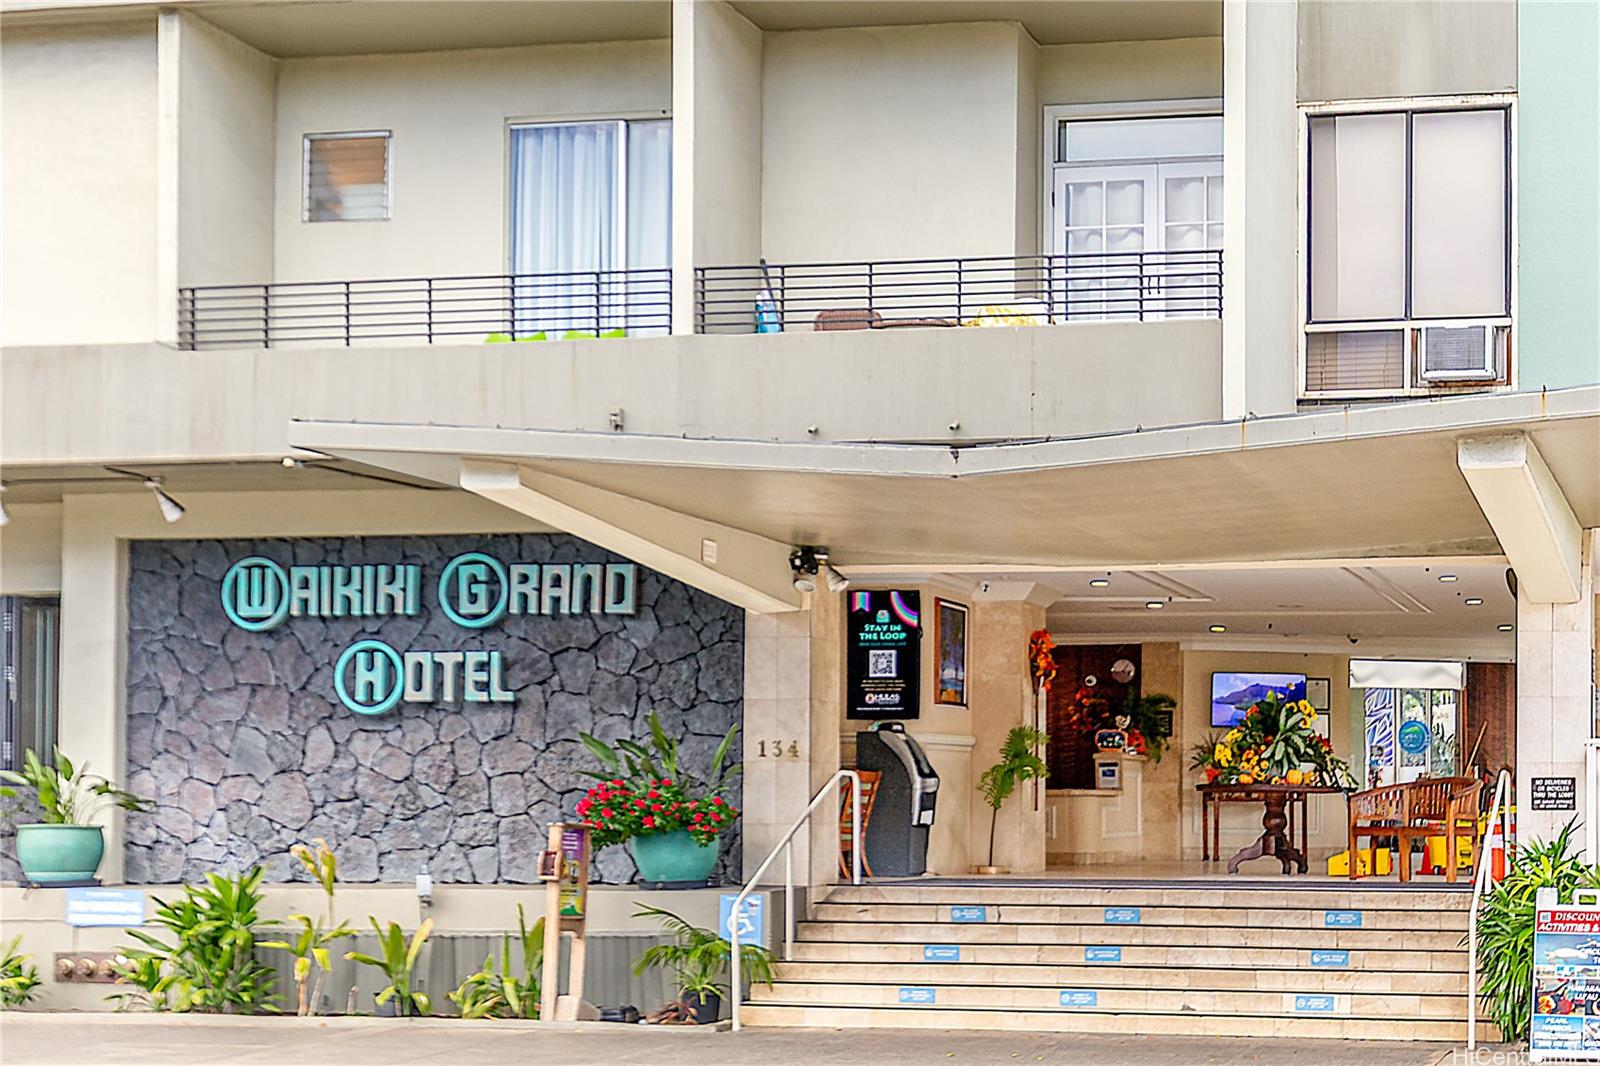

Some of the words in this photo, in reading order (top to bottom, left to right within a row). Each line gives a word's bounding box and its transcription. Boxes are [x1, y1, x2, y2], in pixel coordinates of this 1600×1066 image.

[235, 562, 421, 619] WAIKIKI
[864, 624, 888, 632] STAY
[890, 624, 902, 632] IN
[859, 632, 878, 640] THE
[879, 632, 907, 640] LOOP
[352, 648, 516, 704] HOTEL
[757, 739, 799, 758] 134
[1538, 923, 1591, 931] ACTIVITIES
